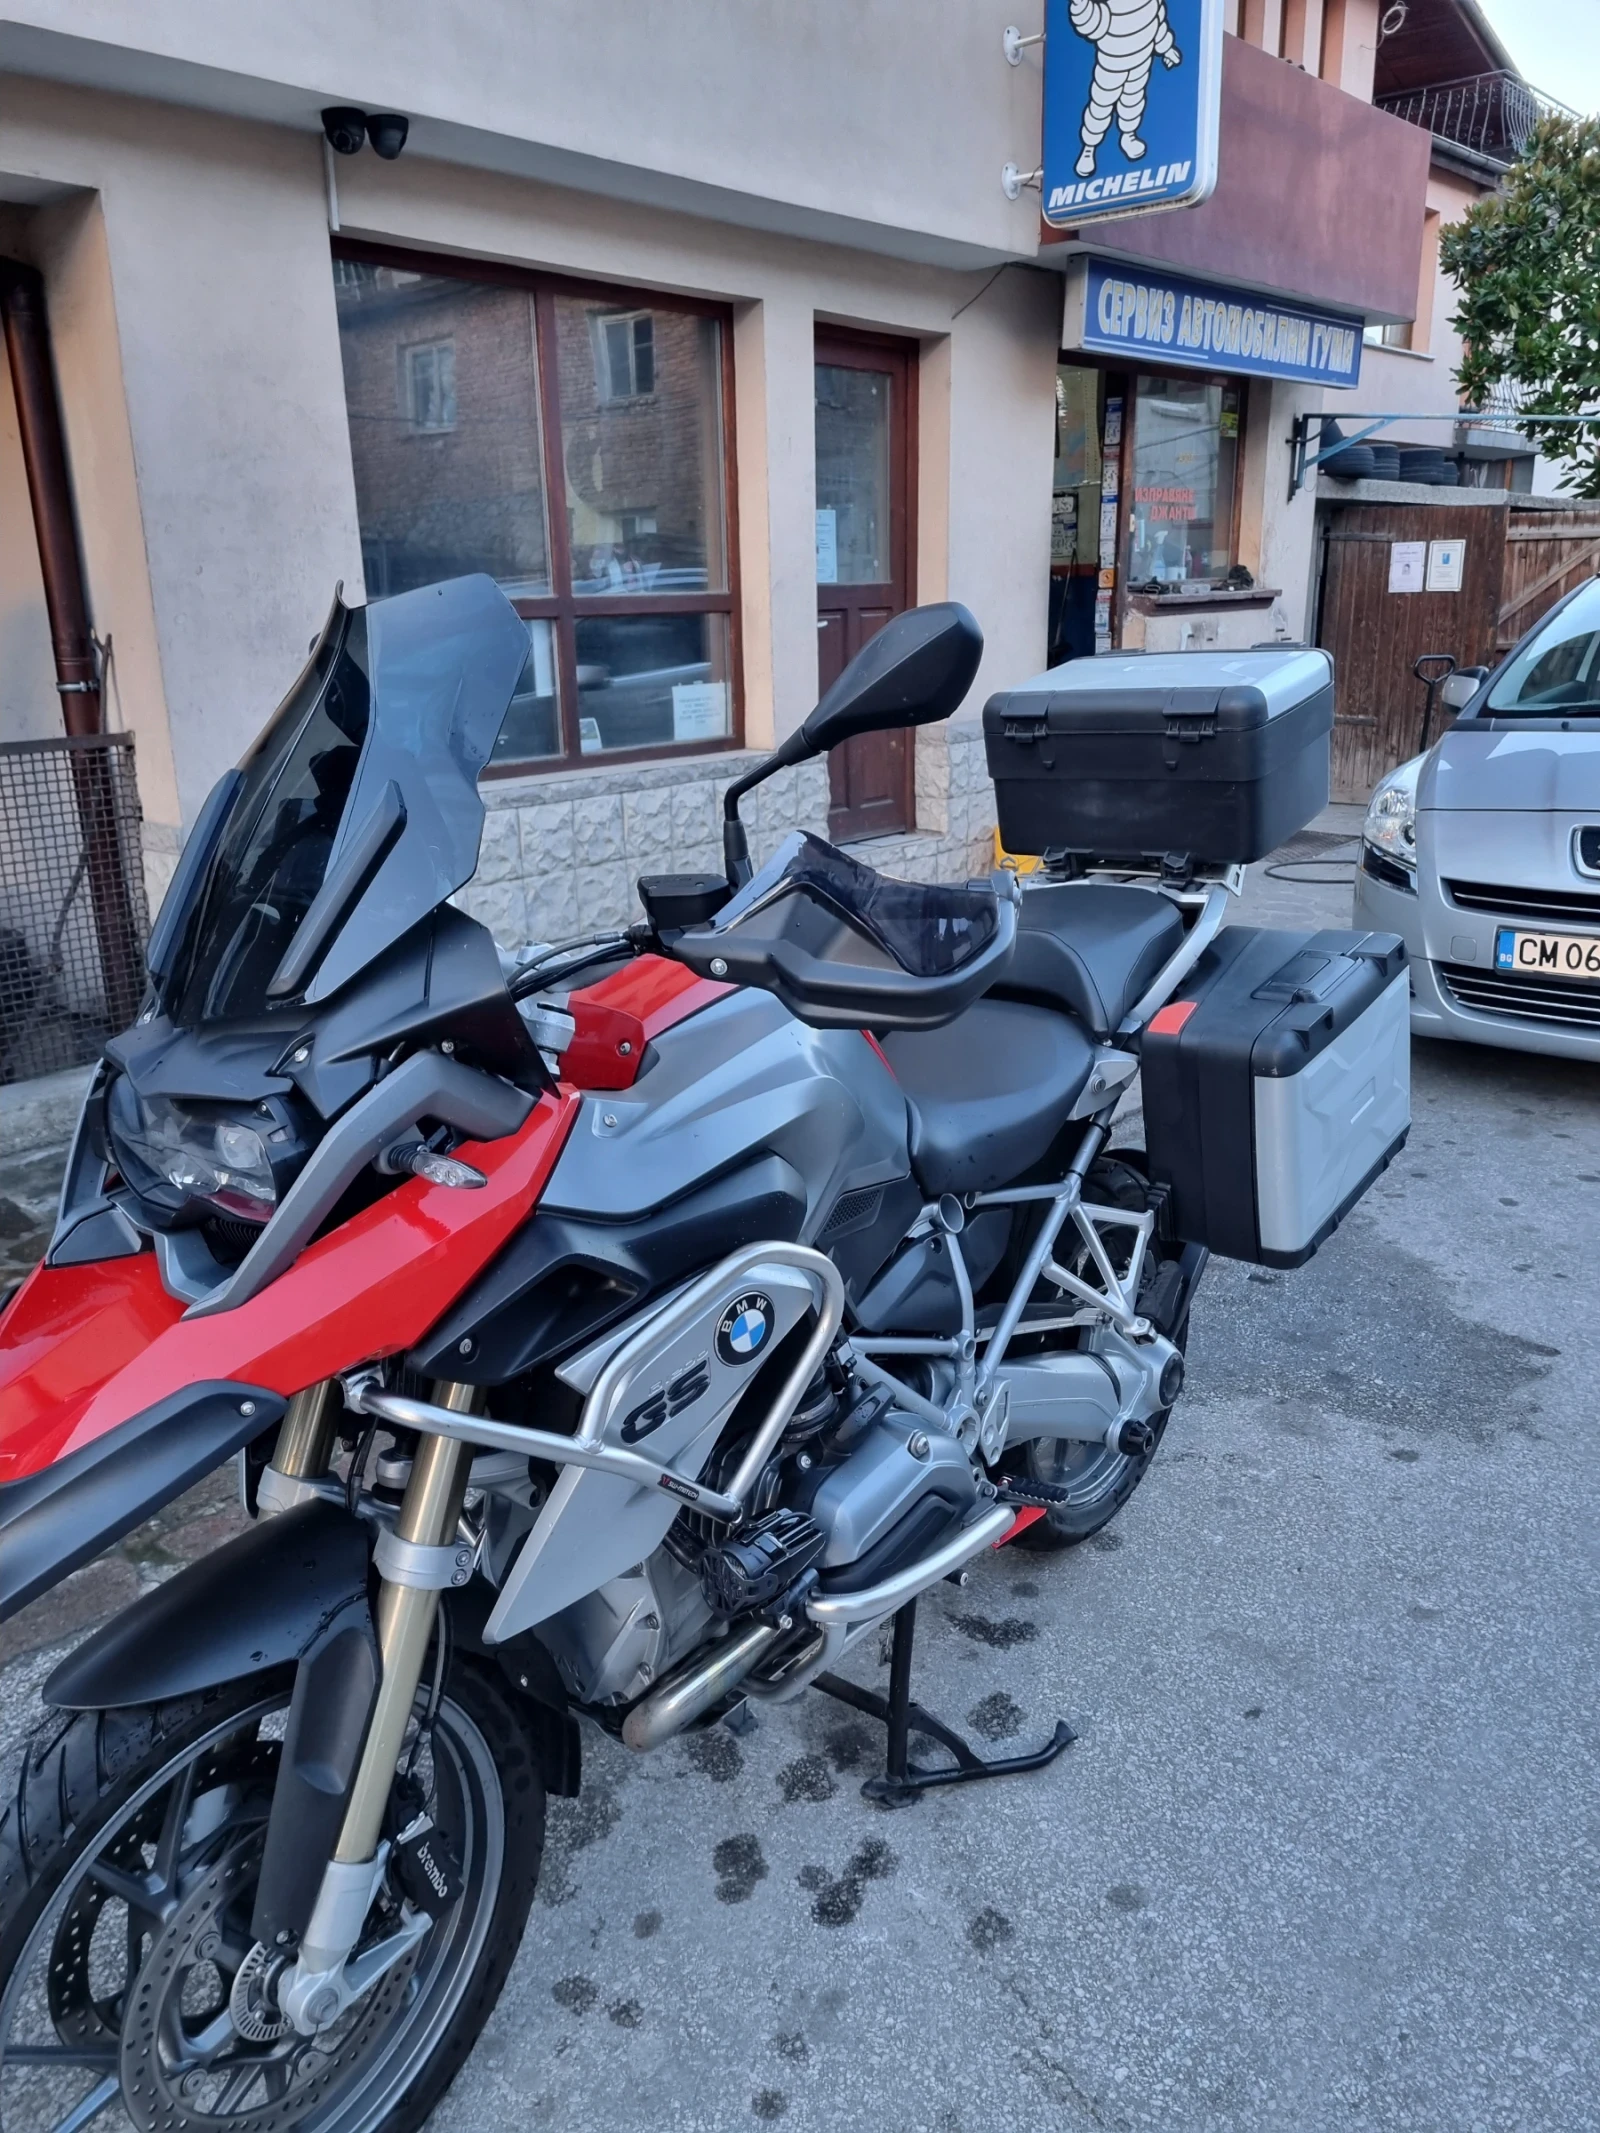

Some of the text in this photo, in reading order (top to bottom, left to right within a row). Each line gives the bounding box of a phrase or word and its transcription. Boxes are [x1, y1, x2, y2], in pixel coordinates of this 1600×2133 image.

[1048, 160, 1191, 208] MICHELIN
[1097, 278, 1356, 374] СЕРВИЗ АВТОМОБИЛНИ ГУМИ
[1499, 953, 1513, 963] BG
[1519, 937, 1600, 972] CM 06
[721, 1296, 768, 1334] BMW
[620, 1359, 712, 1445] GS
[416, 1841, 448, 1898] brembo
